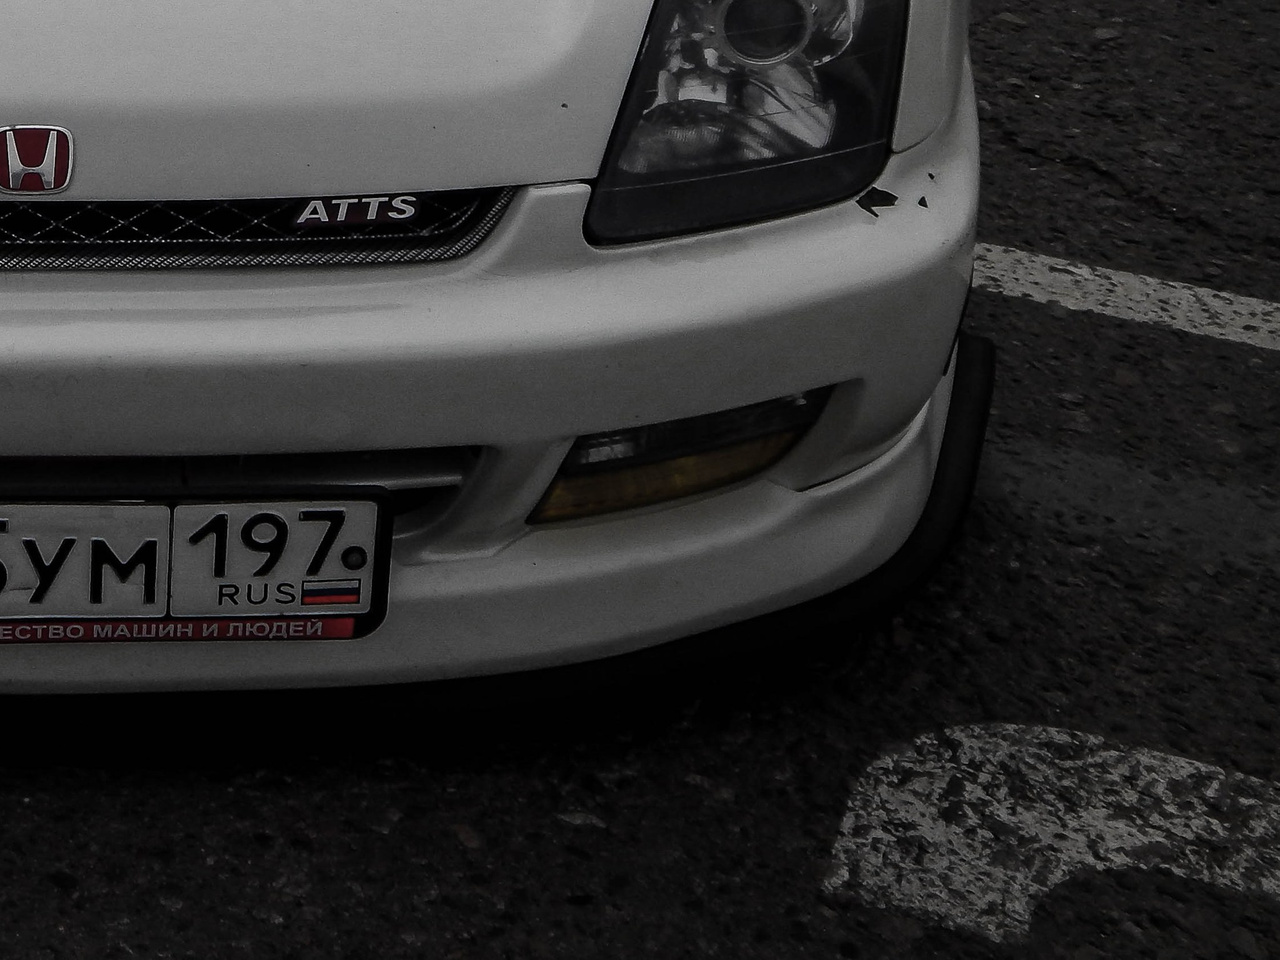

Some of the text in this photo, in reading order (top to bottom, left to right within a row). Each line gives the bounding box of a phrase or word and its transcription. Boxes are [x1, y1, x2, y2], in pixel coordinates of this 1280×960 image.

[296, 195, 417, 224] ATTS
[188, 510, 347, 579] 197
[217, 583, 297, 606] RUS
[93, 622, 194, 639] МАШИН
[202, 623, 220, 638] И
[228, 619, 324, 639] ЛЮДЕЙ
